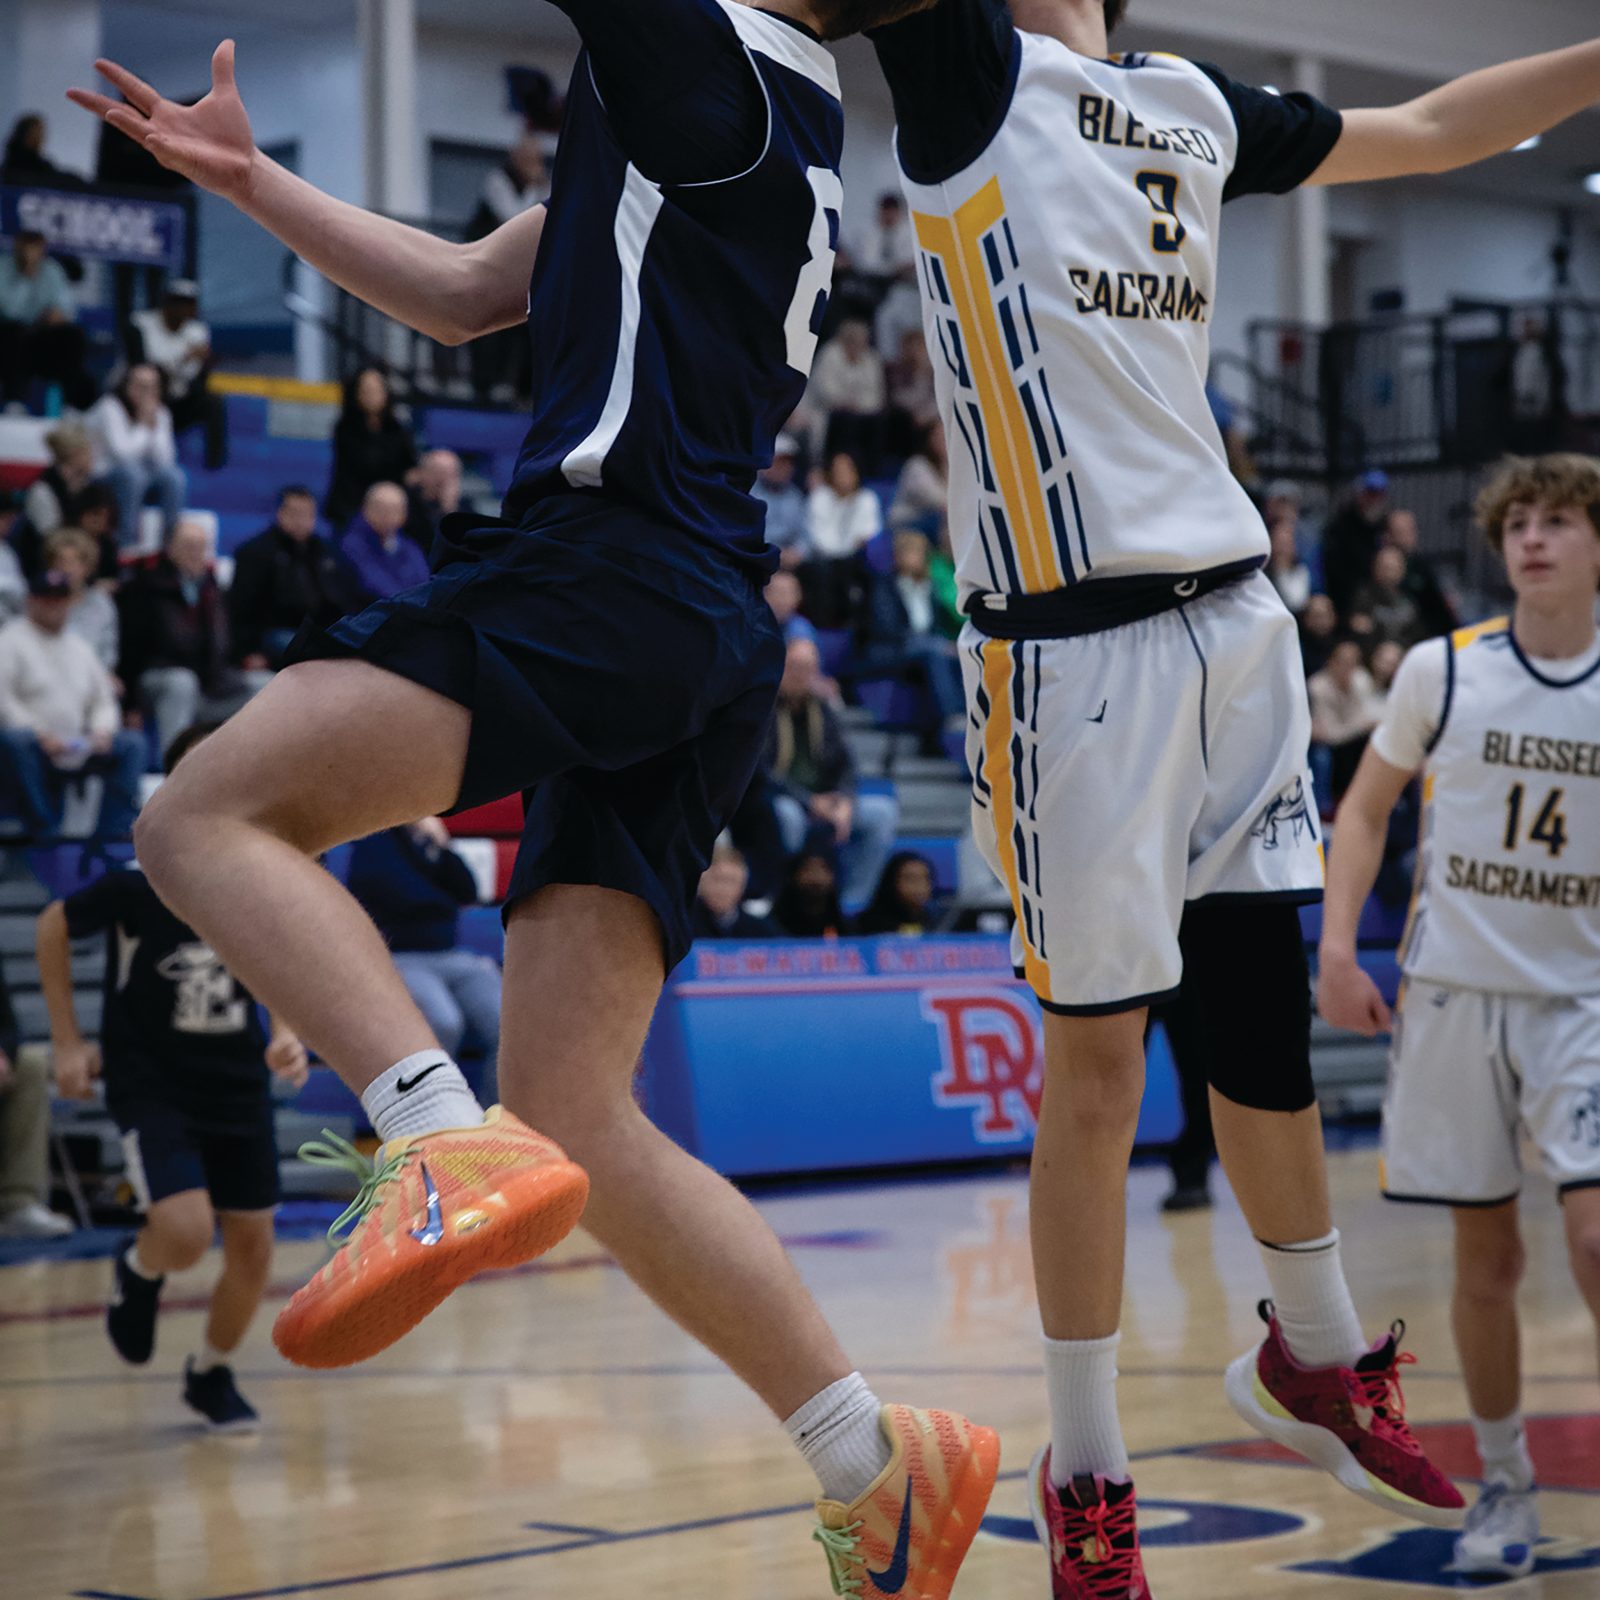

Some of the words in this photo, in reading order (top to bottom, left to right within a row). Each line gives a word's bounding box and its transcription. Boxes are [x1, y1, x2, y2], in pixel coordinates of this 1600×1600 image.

[1135, 169, 1187, 255] 9
[1067, 268, 1208, 324] SACRAM
[1504, 781, 1567, 858] 14
